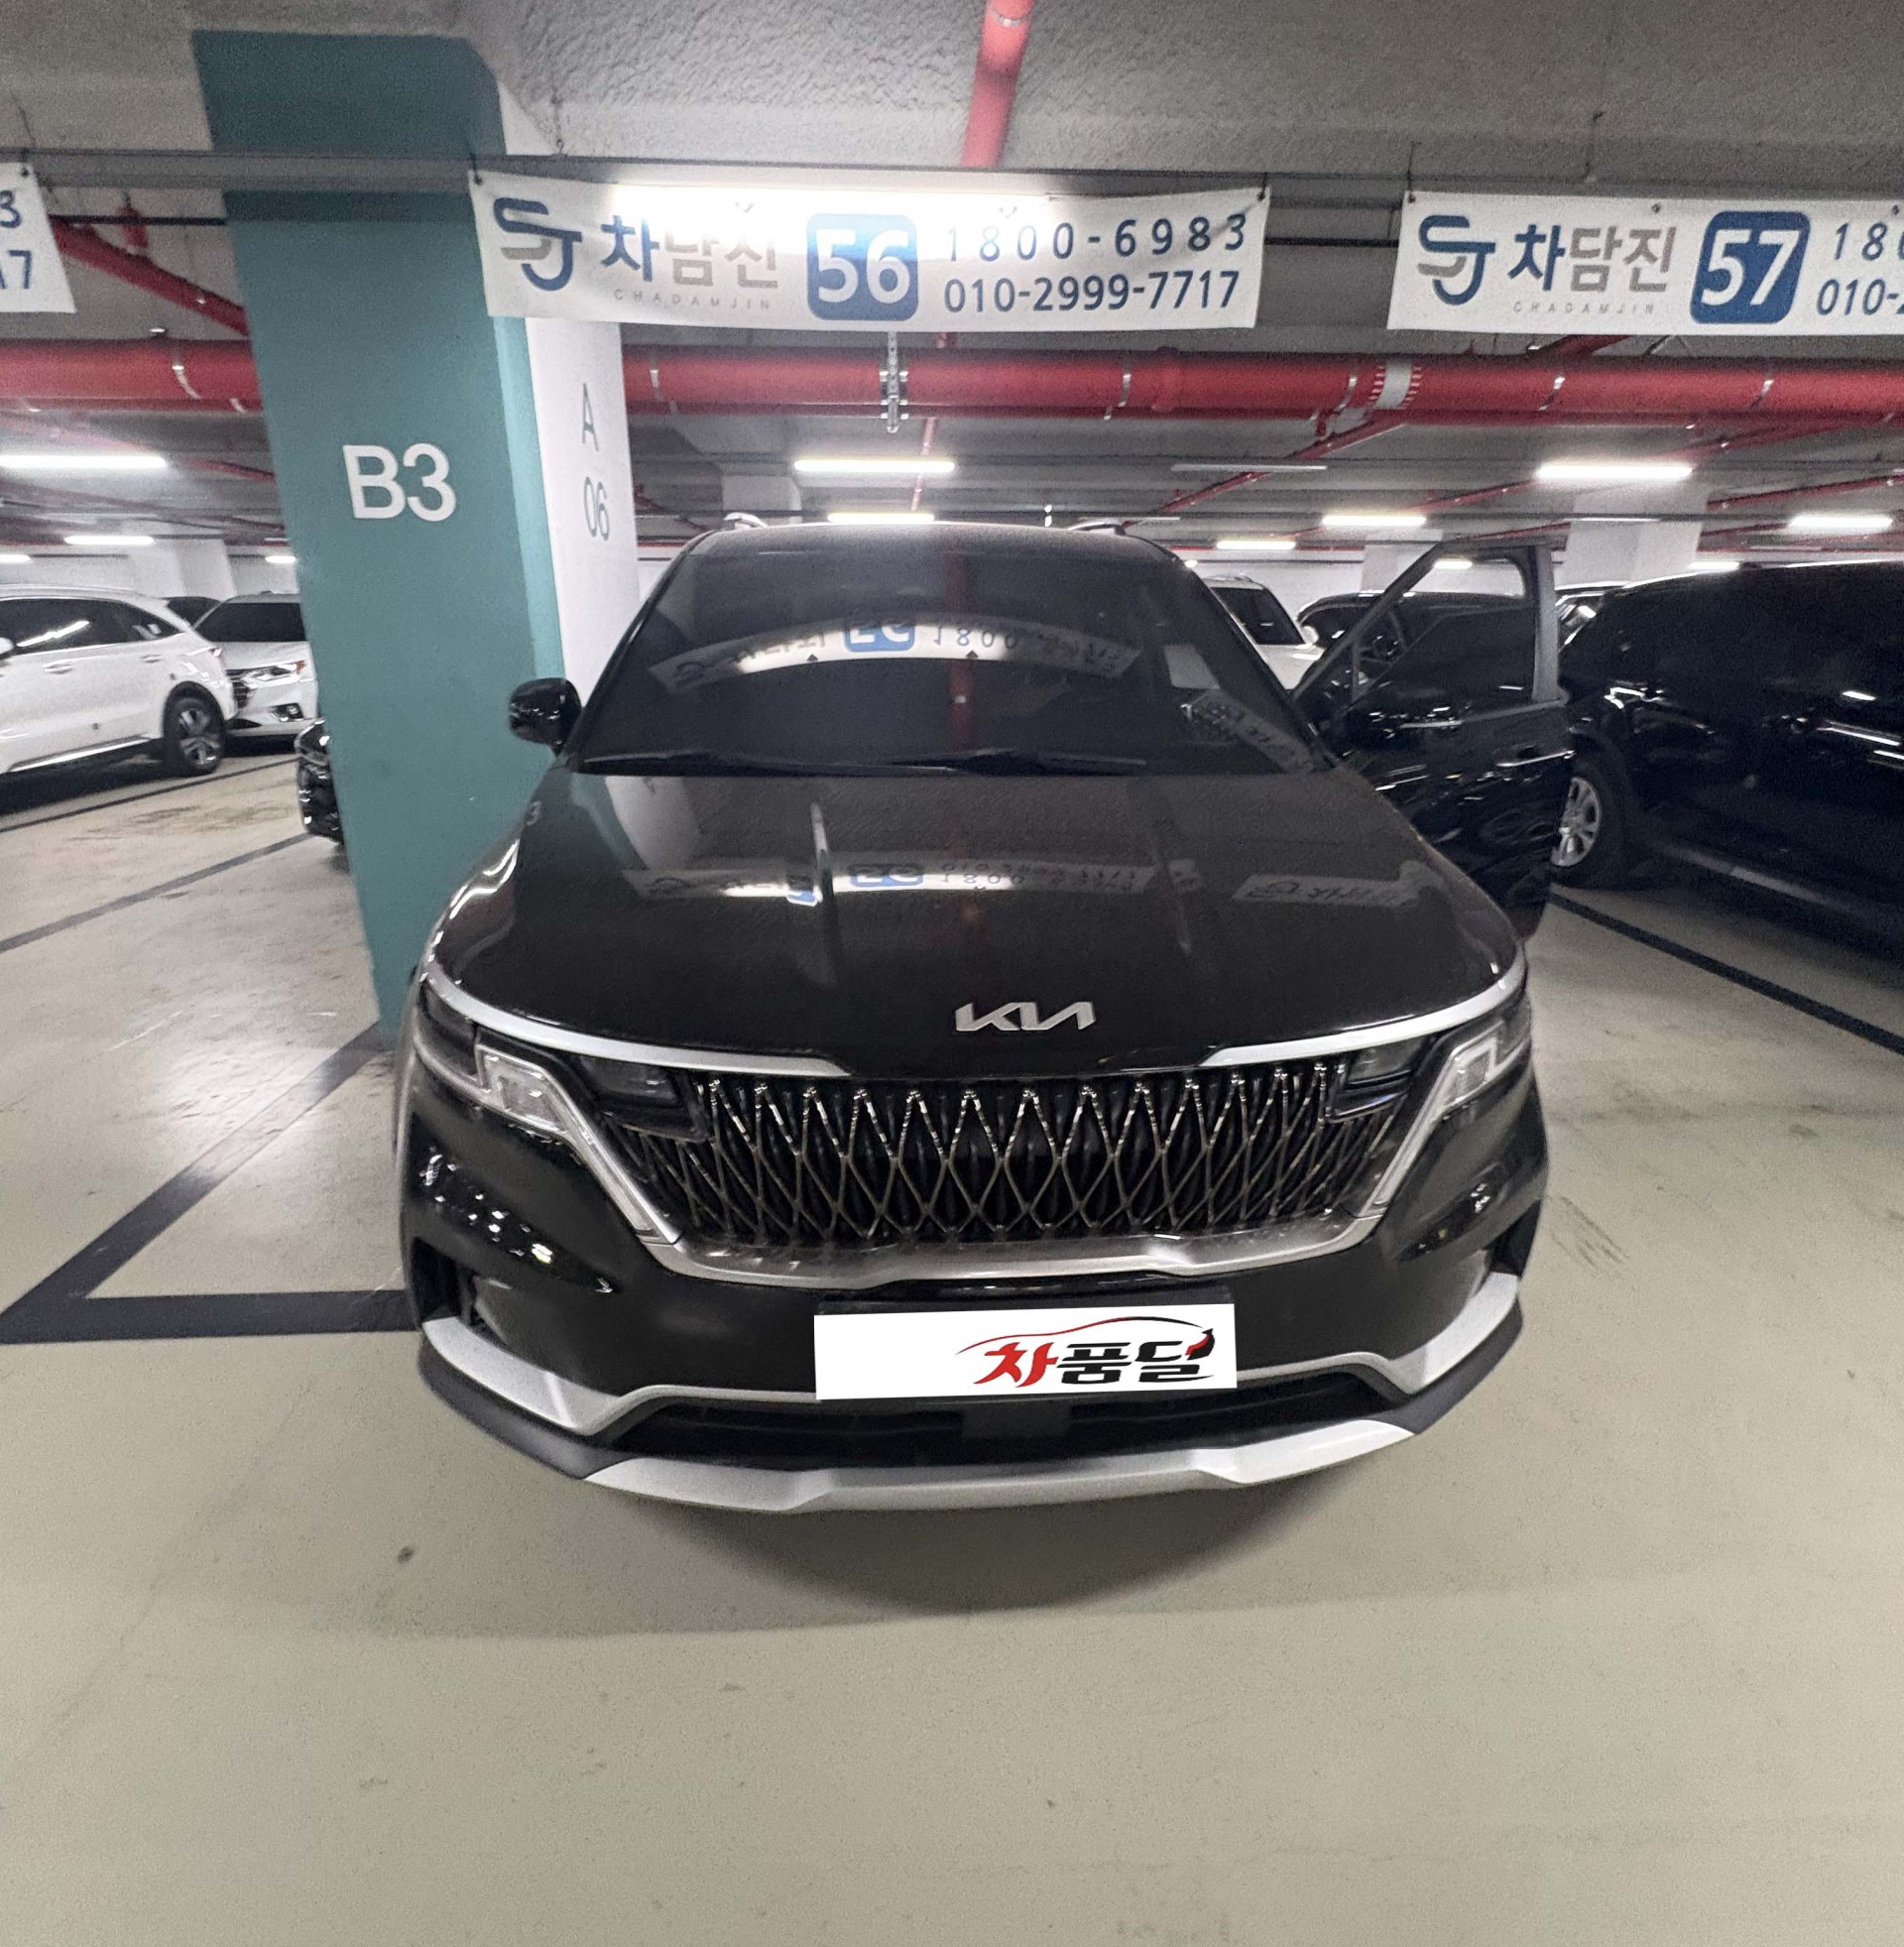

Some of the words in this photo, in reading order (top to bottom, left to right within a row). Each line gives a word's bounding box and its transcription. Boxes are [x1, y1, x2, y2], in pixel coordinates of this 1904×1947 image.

[815, 227, 910, 304] 56
[945, 213, 1247, 263] 1800-6983
[1506, 223, 1678, 293] 차담진
[1700, 228, 1800, 306] 57
[1834, 221, 1904, 262] 18
[613, 289, 771, 310] CHADAMJIN
[943, 269, 1241, 313] 010-2999-7717
[1816, 278, 1904, 316] 010-
[581, 382, 599, 452] A
[342, 442, 457, 523] B3
[583, 476, 610, 542] 06
[955, 1001, 1097, 1032] KIA
